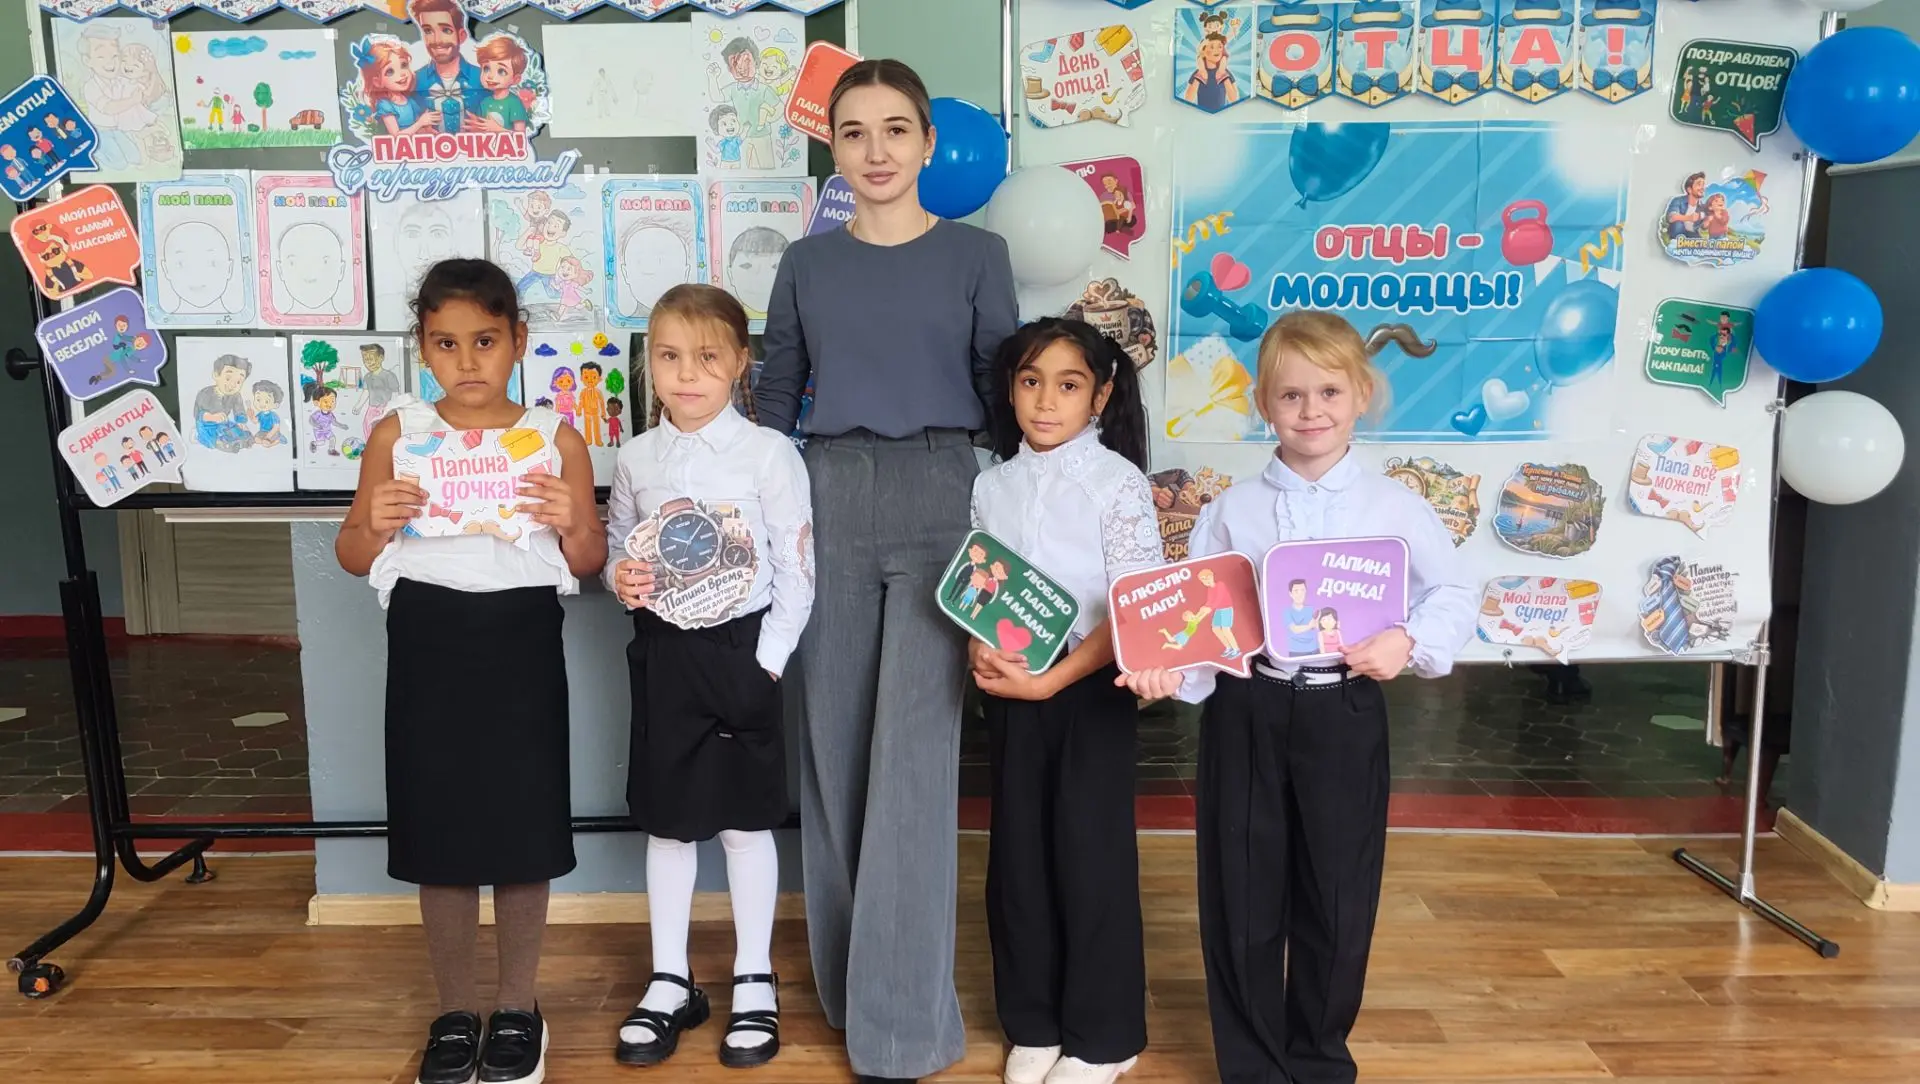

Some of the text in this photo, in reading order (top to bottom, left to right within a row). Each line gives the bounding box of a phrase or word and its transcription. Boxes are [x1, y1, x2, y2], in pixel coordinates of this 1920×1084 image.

[1058, 51, 1100, 76] День
[1686, 47, 1790, 69] ПОЗДРАВЛЯЕМ
[1054, 68, 1110, 98] отца!
[1714, 71, 1782, 91] ОТЦОВ!
[15, 81, 56, 118] ОТЦА!
[796, 96, 825, 117] ПАПА
[791, 111, 816, 130] ВАМ
[373, 133, 528, 162] ПАПОЧКА!
[332, 149, 572, 199] С праздником!
[158, 191, 233, 206] МОЙ ПАПА
[274, 193, 347, 207] МОЙ ПАПА
[620, 196, 691, 211] МОЙ ПАПА
[727, 198, 798, 213] МОЙ ПАПА
[826, 188, 856, 204] ПАП
[59, 200, 119, 224] МОЙ ПАПА
[75, 216, 114, 235] САМЫЙ
[70, 228, 128, 252] КЛАССНЫЙ!
[1316, 225, 1449, 264] ОТЦЫ
[1677, 237, 1708, 249] Вместе
[1716, 239, 1745, 250] папой
[1270, 273, 1522, 314] МОЛОДЦЫ!
[45, 309, 103, 345] С ПАПОЙ
[54, 328, 108, 362] ВЕСЕЛО!
[1654, 346, 1681, 356] ХОЧУ
[1651, 360, 1704, 375] КАК ПАПА!
[79, 422, 116, 453] ДНЁМ
[112, 397, 154, 431] ОТЦА!
[431, 455, 508, 479] Папина
[1655, 456, 1689, 476] Папа
[442, 476, 517, 508] дочка!
[1654, 476, 1711, 496] может!
[1322, 552, 1391, 577] ПАПИНА
[661, 584, 706, 612] Папино
[1023, 569, 1072, 615] ЛЮБЛЮ
[1118, 567, 1192, 607] Я ЛЮБЛЮ
[1317, 578, 1386, 601] ДОЧКА!
[1503, 592, 1567, 605] Мой папа
[1019, 588, 1055, 618] ПАПУ
[1140, 588, 1186, 620] ПАПУ!
[1000, 591, 1055, 645] И МАМУ!
